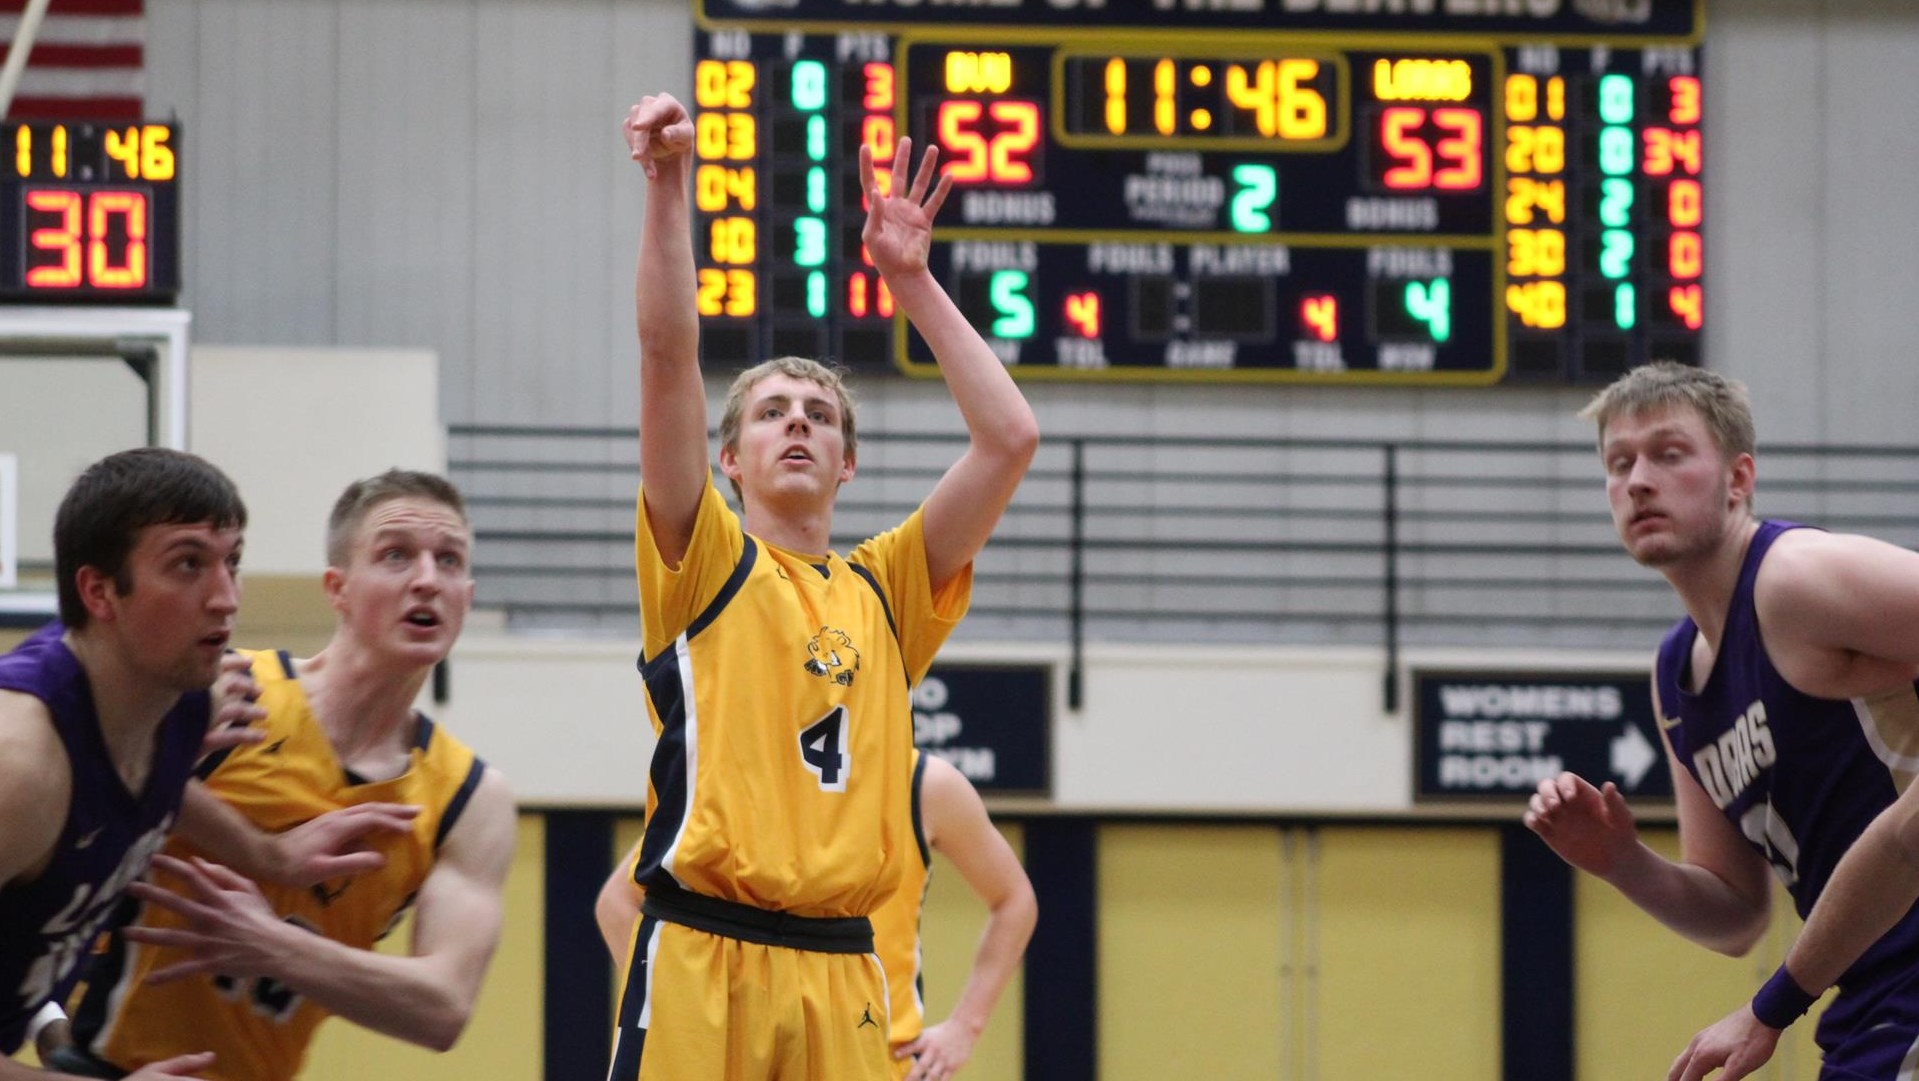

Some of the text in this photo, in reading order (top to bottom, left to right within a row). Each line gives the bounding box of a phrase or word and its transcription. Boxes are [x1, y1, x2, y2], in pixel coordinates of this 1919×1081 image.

[696, 60, 755, 108] 02
[791, 60, 826, 110] 0
[863, 62, 895, 111] 3
[1105, 56, 1327, 140] 11:46
[1505, 74, 1564, 121] 01
[1600, 74, 1634, 124] 0
[1669, 76, 1701, 124] 3
[696, 112, 755, 160] 03
[807, 114, 826, 161] 1
[863, 114, 895, 162] 0
[938, 101, 1040, 183] 52
[1382, 107, 1483, 190] 53
[1505, 126, 1565, 173] 20
[1600, 126, 1634, 175] 0
[1642, 127, 1702, 176] 34
[696, 164, 755, 212] 04
[807, 166, 826, 214] 1
[962, 191, 1054, 224] BONUS
[1231, 164, 1277, 233] 2
[1505, 177, 1565, 224] 24
[1600, 178, 1634, 227] 2
[1668, 179, 1702, 228] 0
[1346, 197, 1439, 231] BONUS
[26, 190, 146, 288] 30
[710, 217, 755, 264] 10
[793, 217, 826, 267] 3
[952, 241, 1038, 272] FOULS
[1087, 243, 1289, 276] FOULS PLAYER
[1368, 247, 1453, 277] FOULS
[1506, 229, 1566, 276] 30
[1600, 229, 1634, 278] 2
[1668, 231, 1702, 279] 0
[697, 269, 755, 317] 23
[807, 271, 826, 318] 1
[990, 270, 1035, 338] 5
[1065, 291, 1099, 339] 4
[1405, 276, 1450, 342] 4
[1505, 281, 1567, 328] 40
[1615, 282, 1635, 329] 1
[1668, 284, 1703, 329] 4
[1302, 295, 1337, 342] 4
[1439, 685, 1622, 720] WOMENS
[798, 704, 852, 792] 4
[1439, 720, 1549, 752] REST
[1438, 755, 1563, 787] ROOM
